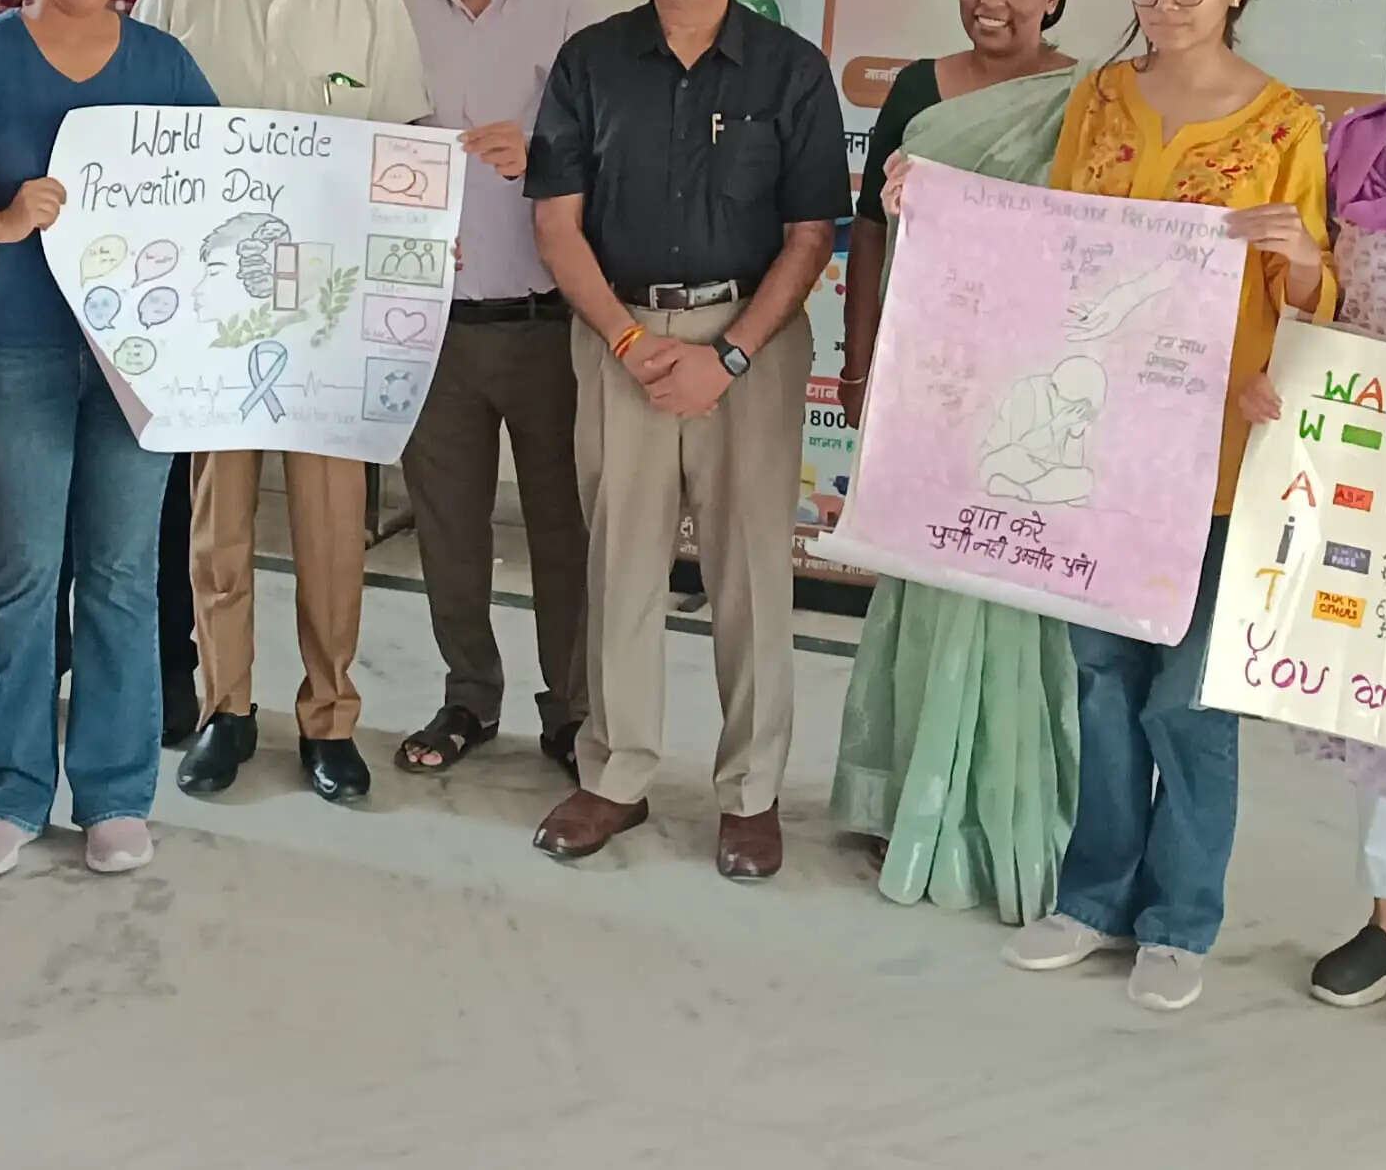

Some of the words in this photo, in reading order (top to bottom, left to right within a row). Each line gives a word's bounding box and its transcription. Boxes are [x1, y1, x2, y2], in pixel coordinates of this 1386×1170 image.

[131, 109, 202, 158] World
[223, 116, 332, 159] Suicide
[80, 161, 207, 212] Prevention
[222, 167, 286, 213] Day
[964, 185, 1031, 211] WORLD
[1042, 196, 1109, 223] SUICIDE
[1299, 410, 1325, 442] W
[1281, 469, 1317, 508] A
[958, 505, 1009, 531] बात
[1255, 568, 1286, 612] T
